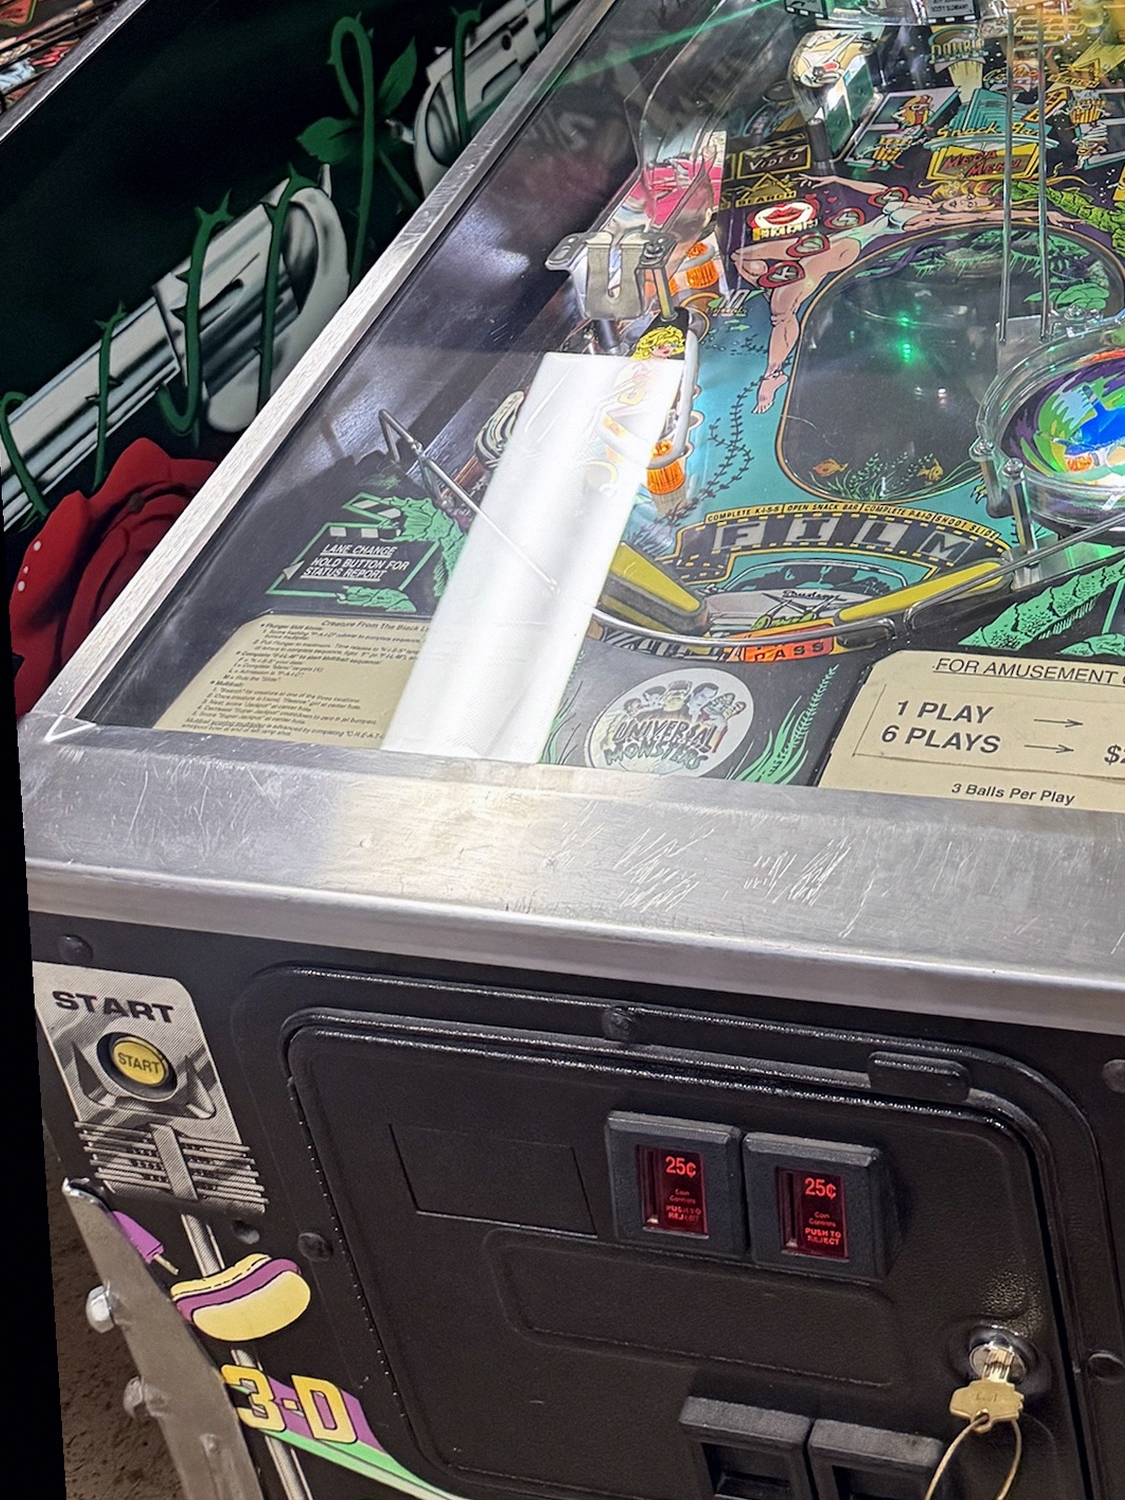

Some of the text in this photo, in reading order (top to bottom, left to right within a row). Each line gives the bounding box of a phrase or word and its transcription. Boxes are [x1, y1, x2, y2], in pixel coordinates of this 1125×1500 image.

[936, 120, 998, 138] Snack
[941, 150, 998, 171] MEGA
[707, 508, 751, 522] COMPLETE
[842, 503, 859, 511] BAR
[864, 504, 905, 516] COMPLETE
[935, 515, 1000, 540] SHOOT SLIDE
[322, 543, 398, 556] LANE CHANGE
[303, 567, 387, 579] STATUS REPORT
[311, 557, 410, 571] HOLD BUTTON FOR
[321, 619, 356, 628] Creature
[356, 621, 379, 629] From
[754, 640, 826, 662] PASS
[935, 658, 981, 675] FOR
[984, 661, 1119, 687] AMUSEMENT
[897, 700, 909, 717] 1
[917, 701, 994, 725] PLAY
[612, 719, 718, 753] UNIVERSAL
[881, 725, 899, 744] 6
[904, 728, 1001, 755] PLAYS
[604, 741, 709, 770] MONSTERS
[951, 782, 1076, 806] 3 Balls Per Play
[52, 990, 173, 1023] START
[117, 1052, 160, 1075] START
[665, 1156, 697, 1177] 25¢
[675, 1188, 690, 1196] Coin
[805, 1177, 837, 1199] 25¢
[805, 1227, 841, 1238] PUSH TO
[807, 1235, 840, 1245] REJECT
[220, 1363, 359, 1444] 3-D
